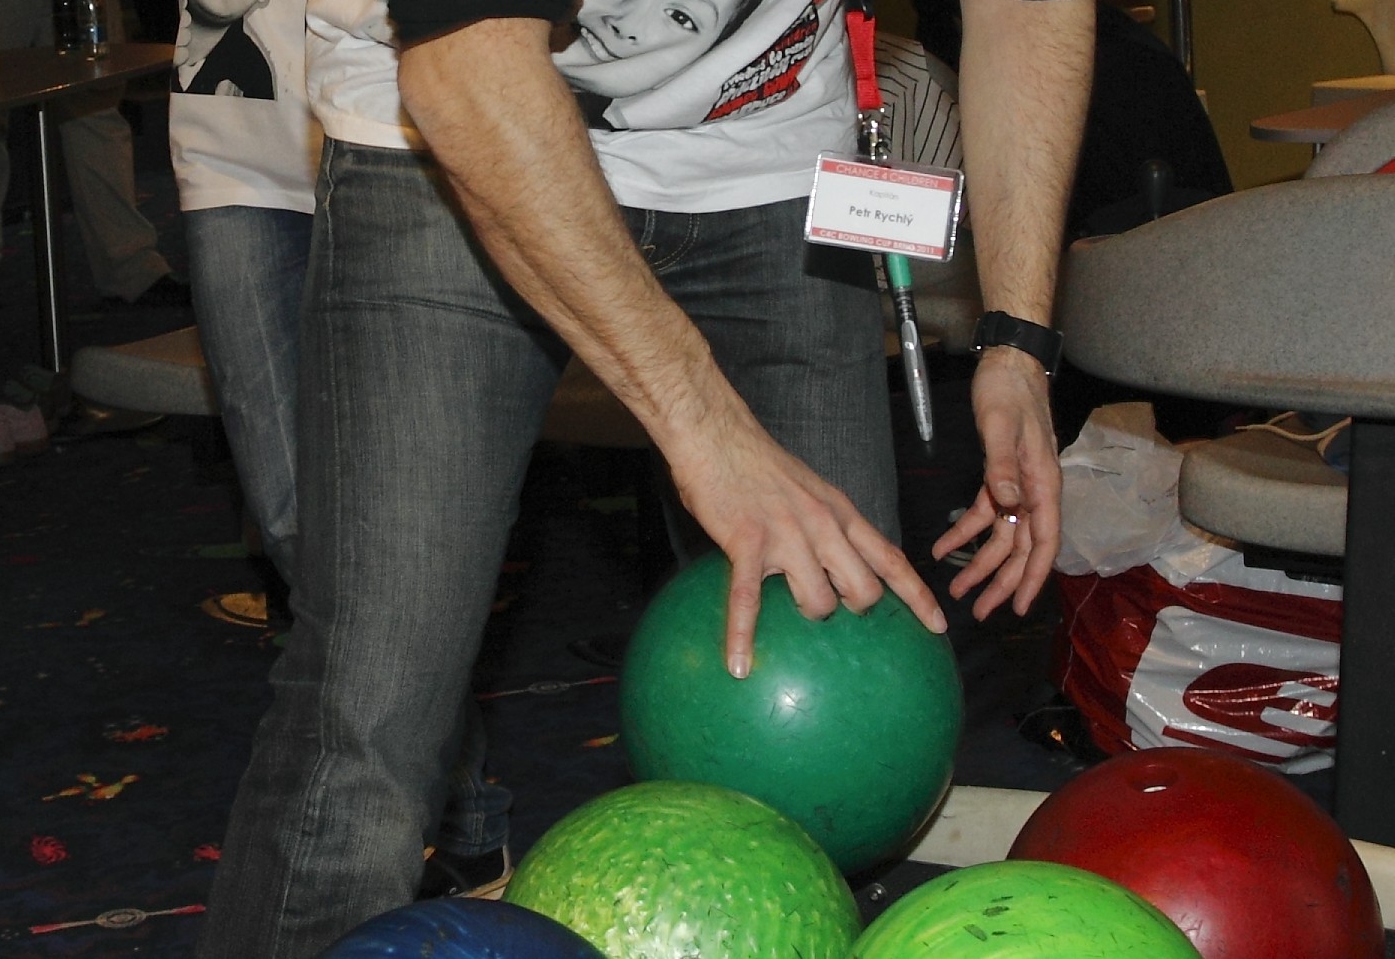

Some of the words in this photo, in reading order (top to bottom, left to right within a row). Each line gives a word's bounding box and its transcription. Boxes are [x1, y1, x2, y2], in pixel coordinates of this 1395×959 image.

[836, 163, 880, 179] CHANCE
[881, 171, 888, 181] 4
[889, 172, 939, 188] CHILDREN
[849, 205, 872, 218] Petr
[874, 209, 914, 227] Rychlý
